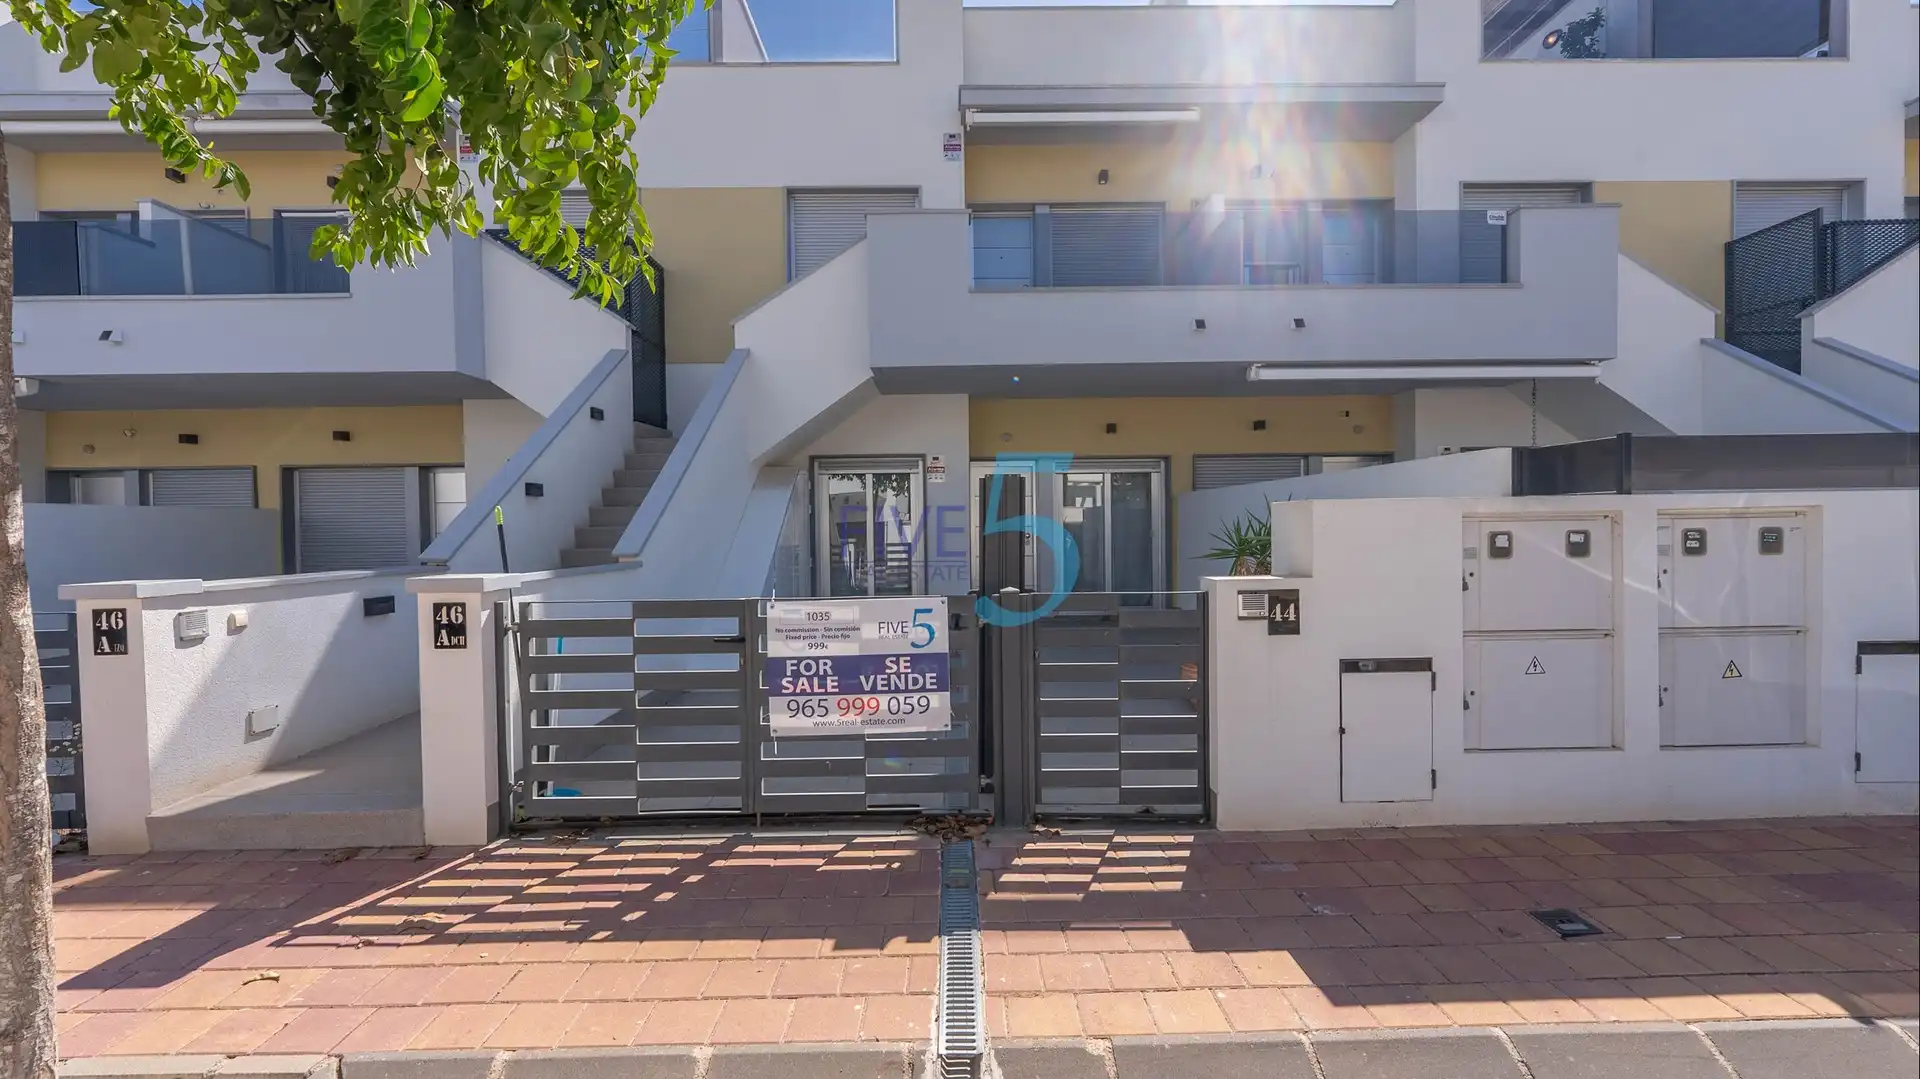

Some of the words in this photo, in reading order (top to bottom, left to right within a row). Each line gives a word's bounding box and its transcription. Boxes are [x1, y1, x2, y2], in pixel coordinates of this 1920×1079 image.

[96, 612, 123, 629] 46
[436, 606, 463, 624] 46
[806, 612, 830, 621] 1035
[1270, 603, 1296, 621] 44
[878, 621, 909, 634] FIVE
[911, 608, 936, 649] 5
[97, 636, 111, 652] A
[436, 630, 450, 645] A
[785, 659, 833, 676] FOR
[885, 656, 912, 674] SE
[781, 676, 839, 693] SALE
[859, 673, 938, 691] VENDE
[787, 699, 829, 718] 965
[837, 697, 880, 717] 999
[887, 695, 931, 716] 059
[812, 717, 906, 727] www.5real-estate.com
